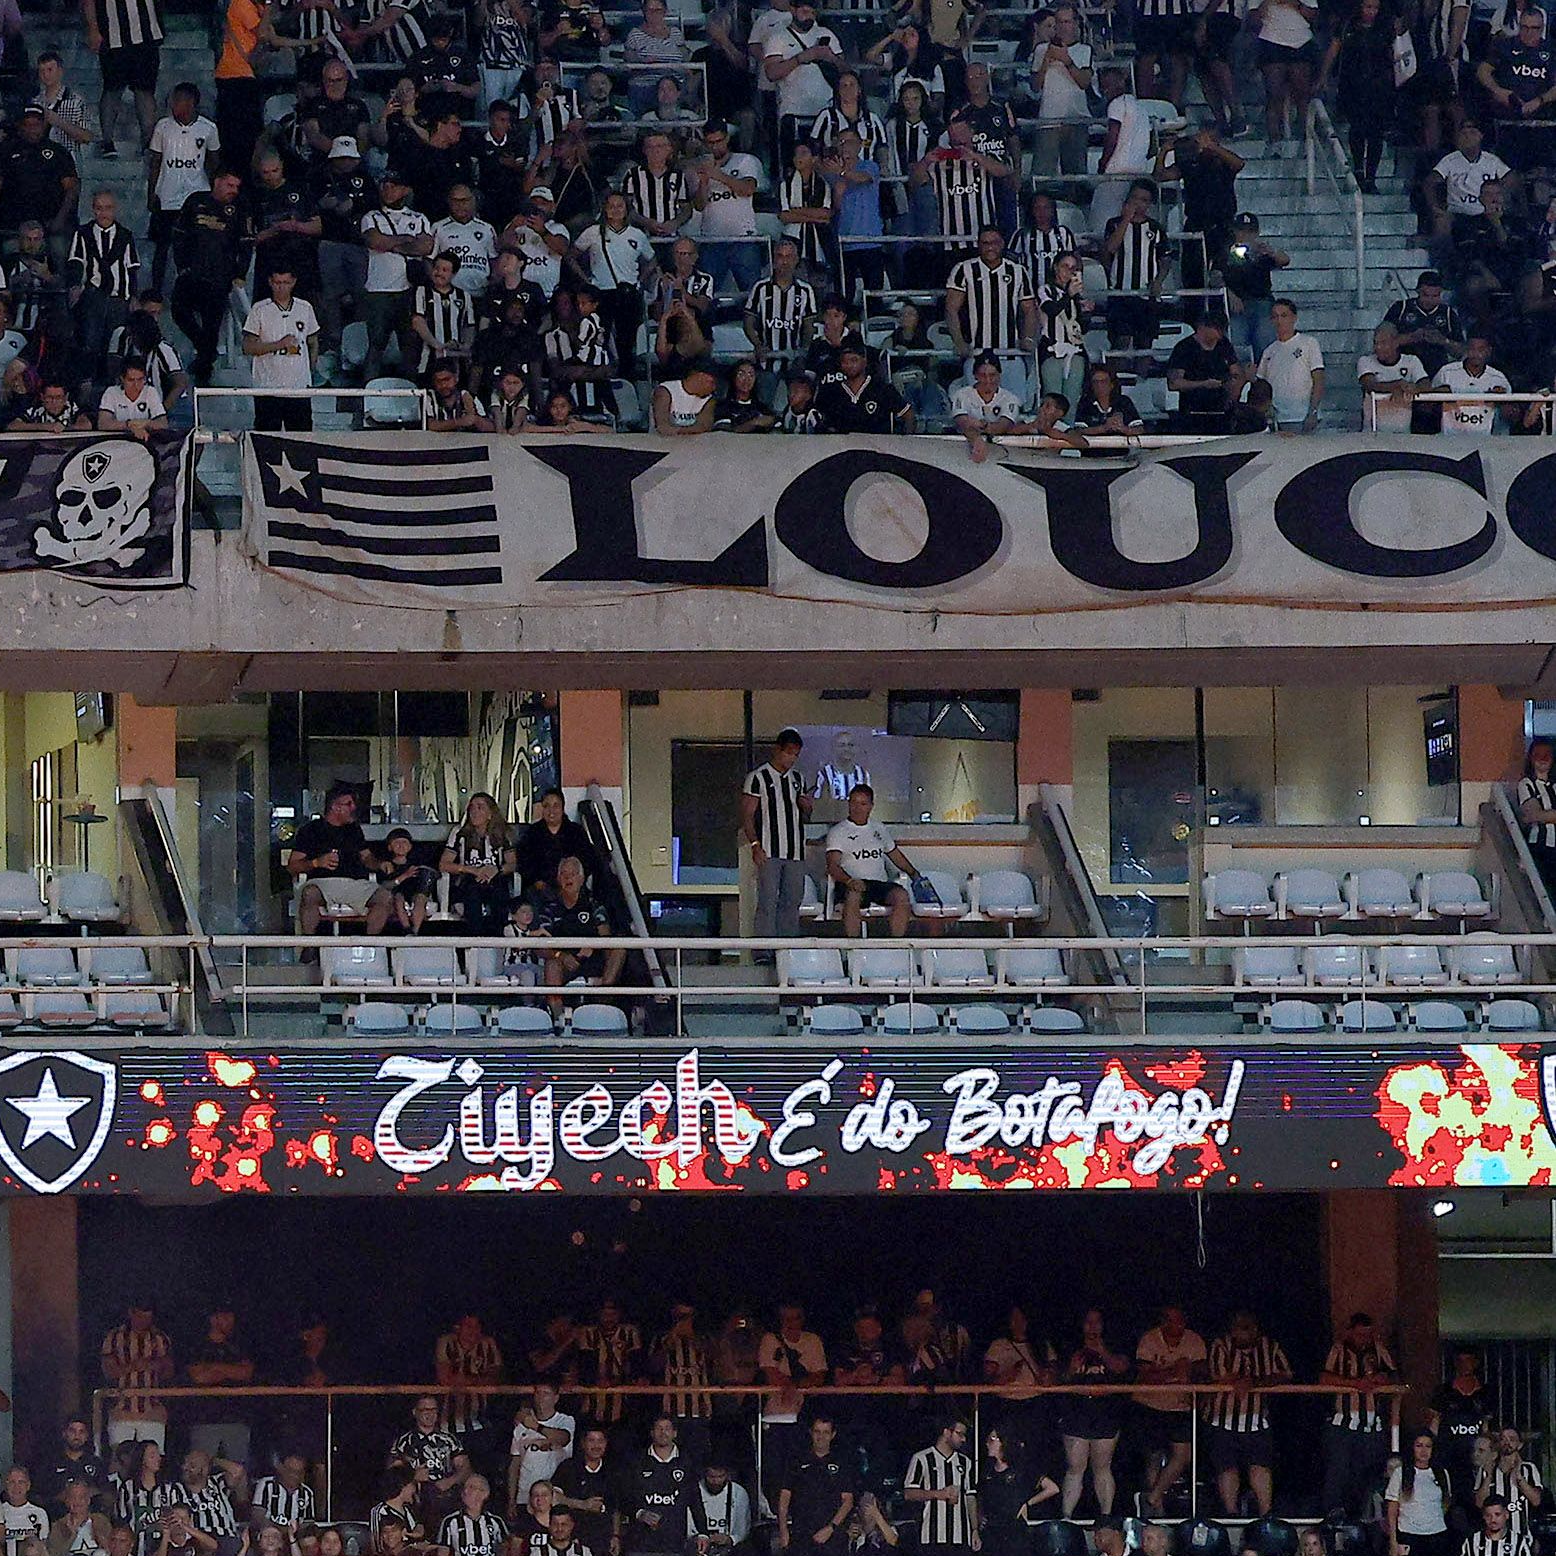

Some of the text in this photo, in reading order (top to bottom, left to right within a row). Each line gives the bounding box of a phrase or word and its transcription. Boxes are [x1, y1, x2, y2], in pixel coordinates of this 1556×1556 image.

[1512, 64, 1546, 78] vbet
[167, 159, 196, 168] vbet
[947, 182, 979, 195] vbet
[527, 257, 547, 266] bet
[766, 318, 795, 329] vbet
[1455, 412, 1483, 424] vbet
[520, 442, 1556, 591] LOUC
[769, 1058, 845, 1165] É
[841, 1077, 931, 1155] do
[945, 1060, 1246, 1176] Botafogo!
[1450, 1422, 1479, 1434] vbet
[645, 1493, 674, 1504] vbet
[1508, 1500, 1521, 1511] et
[272, 1515, 288, 1525] vb
[461, 1544, 491, 1554] vbet
